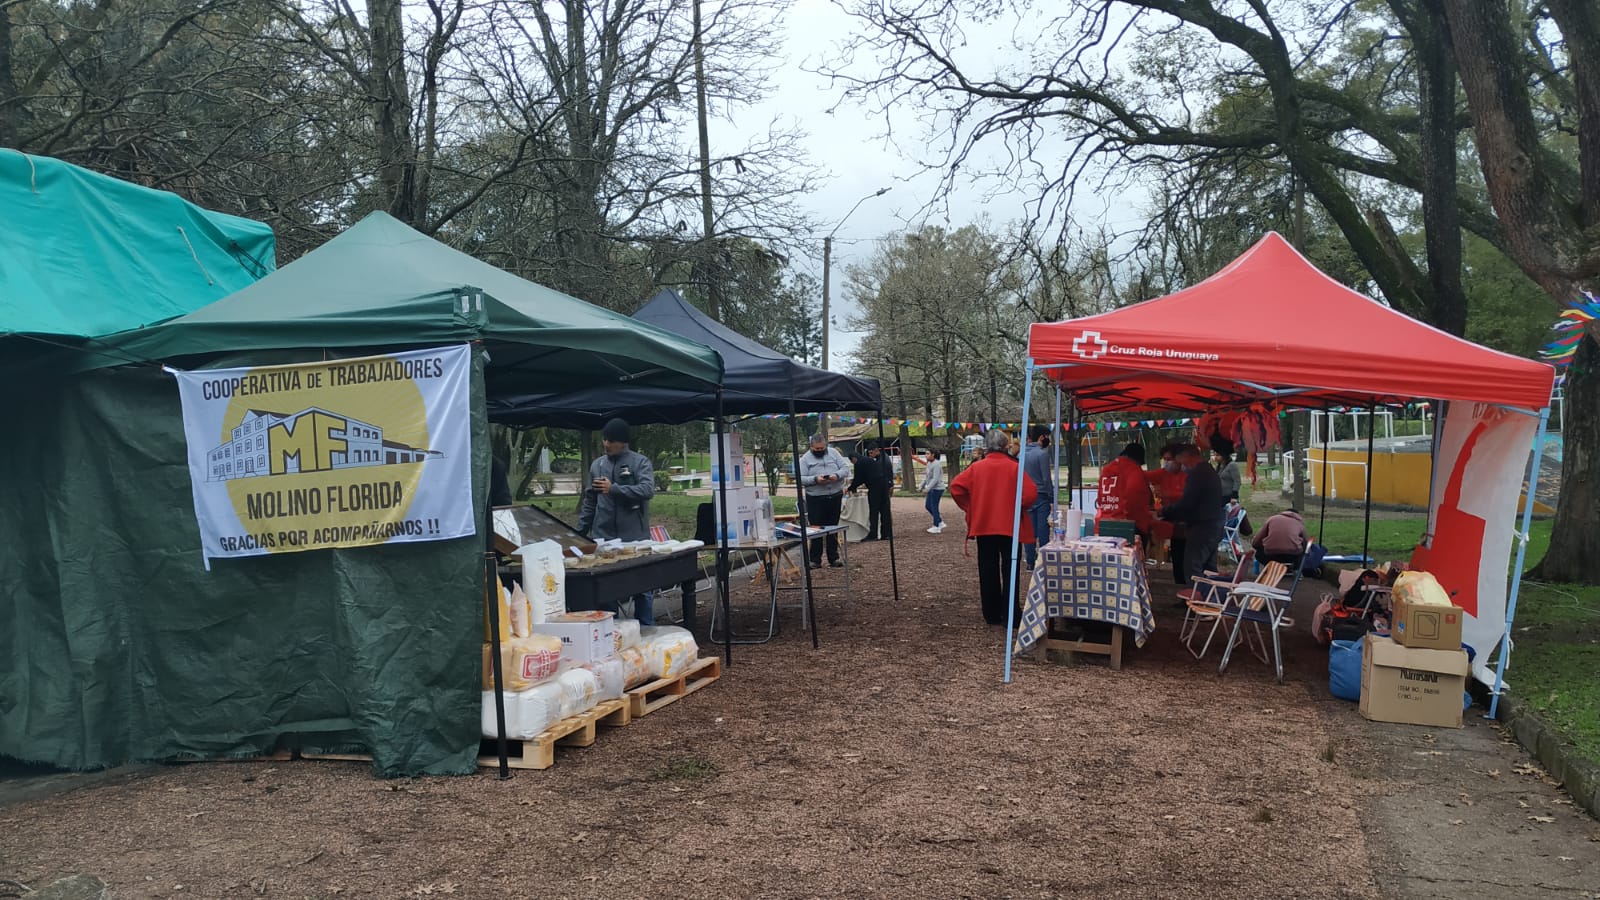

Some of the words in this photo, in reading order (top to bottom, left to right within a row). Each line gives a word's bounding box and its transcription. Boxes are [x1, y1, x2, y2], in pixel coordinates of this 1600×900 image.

[1110, 345, 1135, 355] Cruz
[1138, 347, 1162, 357] Roja
[1165, 349, 1219, 361] Uruguaya
[203, 371, 301, 400] COOPERATIVA
[307, 372, 322, 388] DE
[328, 358, 443, 386] TRABAJADORES
[267, 409, 348, 475] MF
[247, 487, 321, 520] MOLINO
[327, 481, 402, 513] FLORIDA
[220, 532, 276, 551] GRACIAS
[279, 530, 308, 546] POR
[313, 519, 423, 545] ACOMPAÑARNOS
[428, 518, 441, 534] !!
